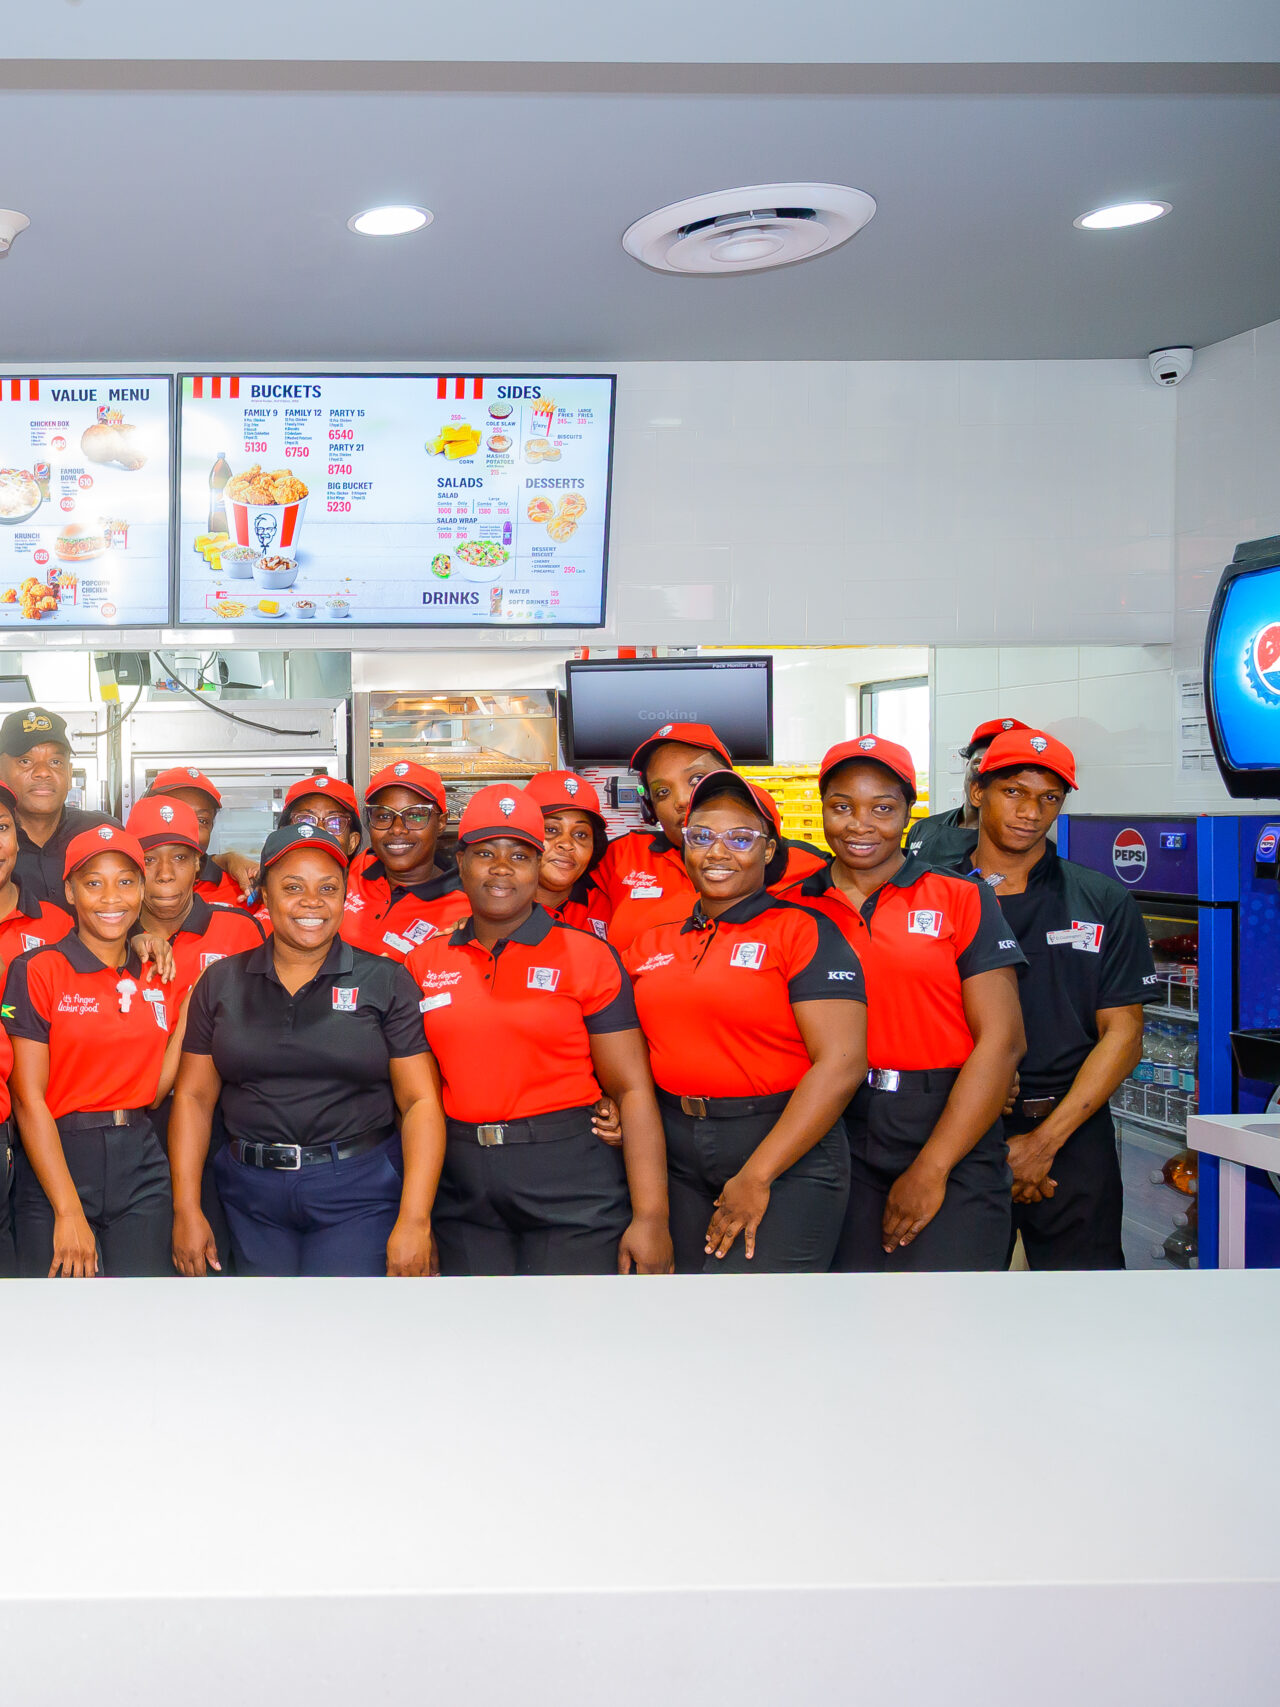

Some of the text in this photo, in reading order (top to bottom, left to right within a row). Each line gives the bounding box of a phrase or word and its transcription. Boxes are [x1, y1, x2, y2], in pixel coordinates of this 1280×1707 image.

[51, 389, 149, 401] VALUE MENU
[251, 385, 322, 398] BUCKETS
[497, 386, 541, 399] SIDES
[244, 409, 270, 417] FAMILY
[285, 409, 312, 417] FAMILY
[329, 429, 353, 440] 6540
[245, 442, 267, 452] 5130
[285, 447, 309, 458] 6750
[328, 465, 352, 475] 8740
[437, 478, 483, 488] SALADS
[526, 479, 585, 488] DESSERTS
[327, 502, 351, 512] 5230
[423, 592, 479, 605] DRINKS
[638, 709, 697, 721] Cooking
[1115, 850, 1145, 861] PEPSI
[828, 972, 854, 980] KFC
[73, 994, 95, 1004] finger
